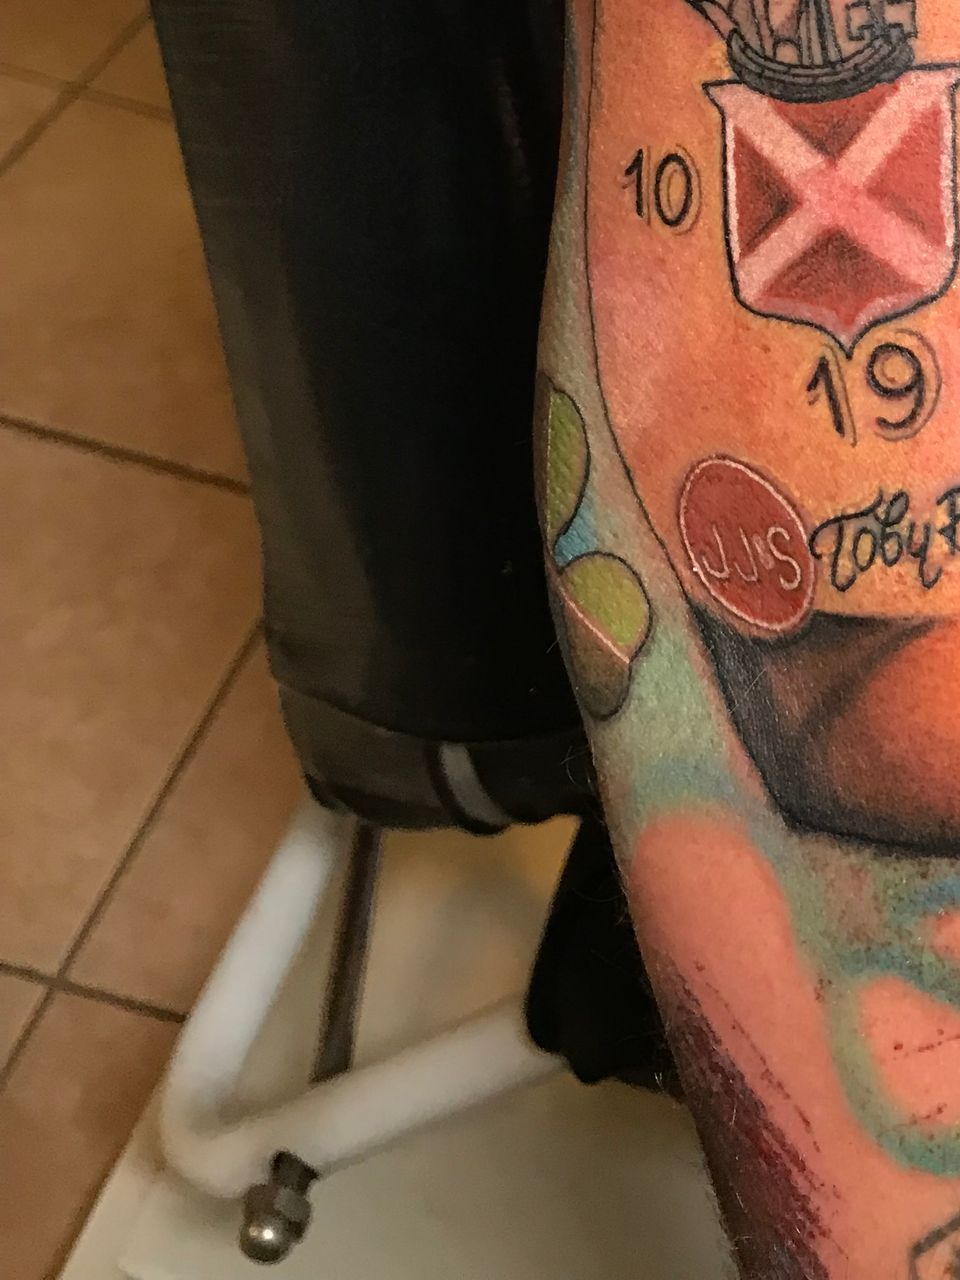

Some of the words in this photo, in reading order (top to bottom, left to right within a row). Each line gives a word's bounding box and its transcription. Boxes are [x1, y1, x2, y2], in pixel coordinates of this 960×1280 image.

[624, 147, 699, 232] 10
[806, 338, 934, 438] 19
[808, 486, 943, 593] Toby
